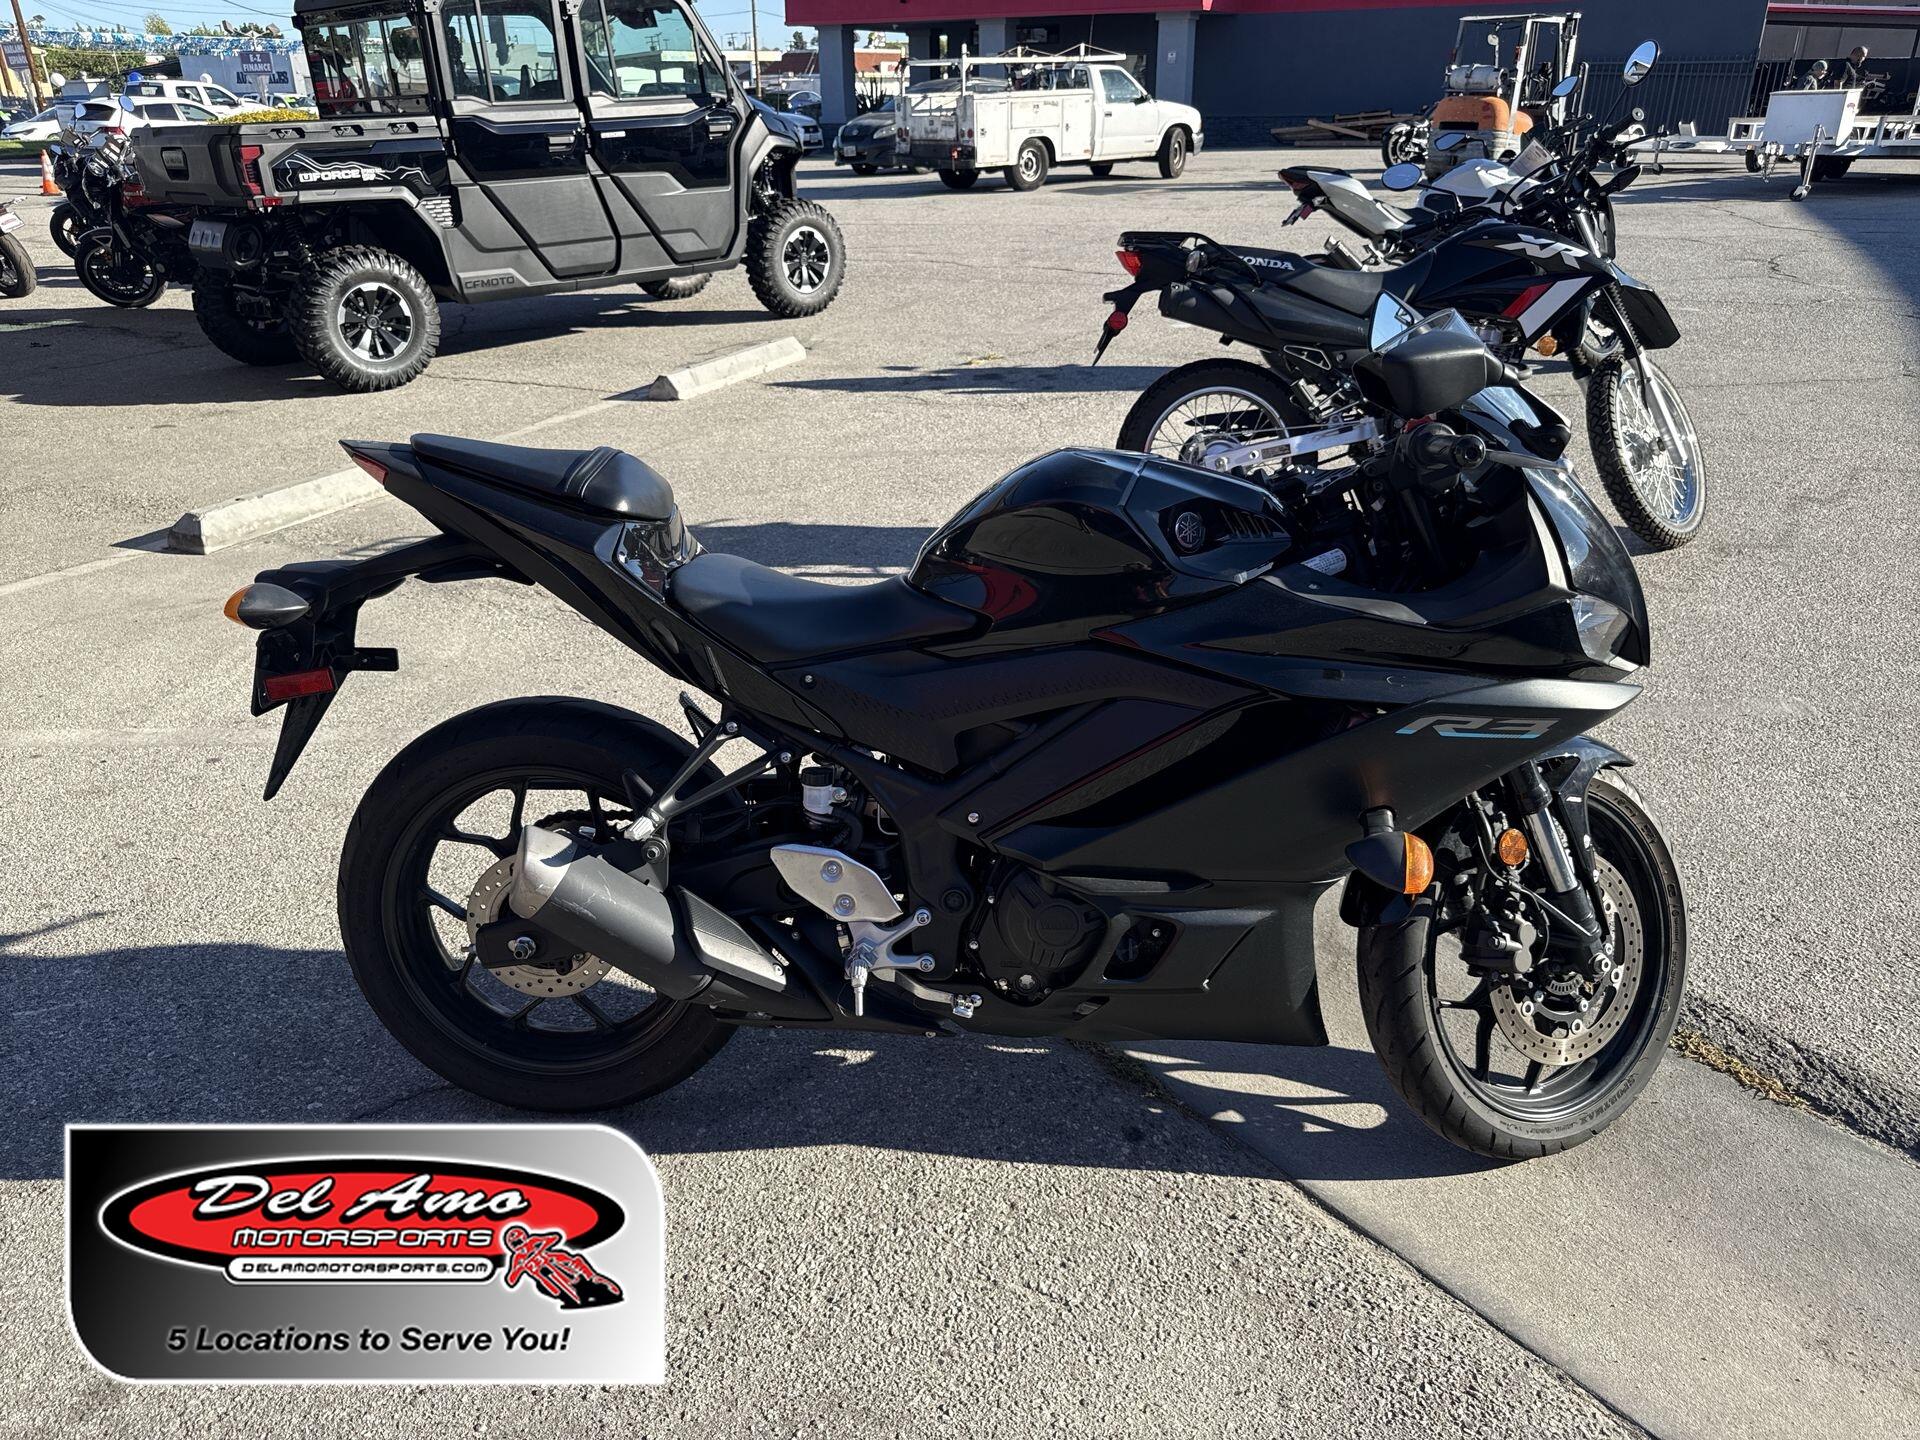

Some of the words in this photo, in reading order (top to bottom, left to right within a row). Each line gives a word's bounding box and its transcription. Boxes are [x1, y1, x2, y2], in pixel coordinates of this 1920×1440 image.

[242, 63, 271, 72] FINANCE
[268, 71, 289, 84] ALES
[1494, 233, 1589, 269] XR
[1238, 255, 1295, 271] ONDA
[465, 276, 515, 289] CFMOTO
[1395, 715, 1562, 739] R3
